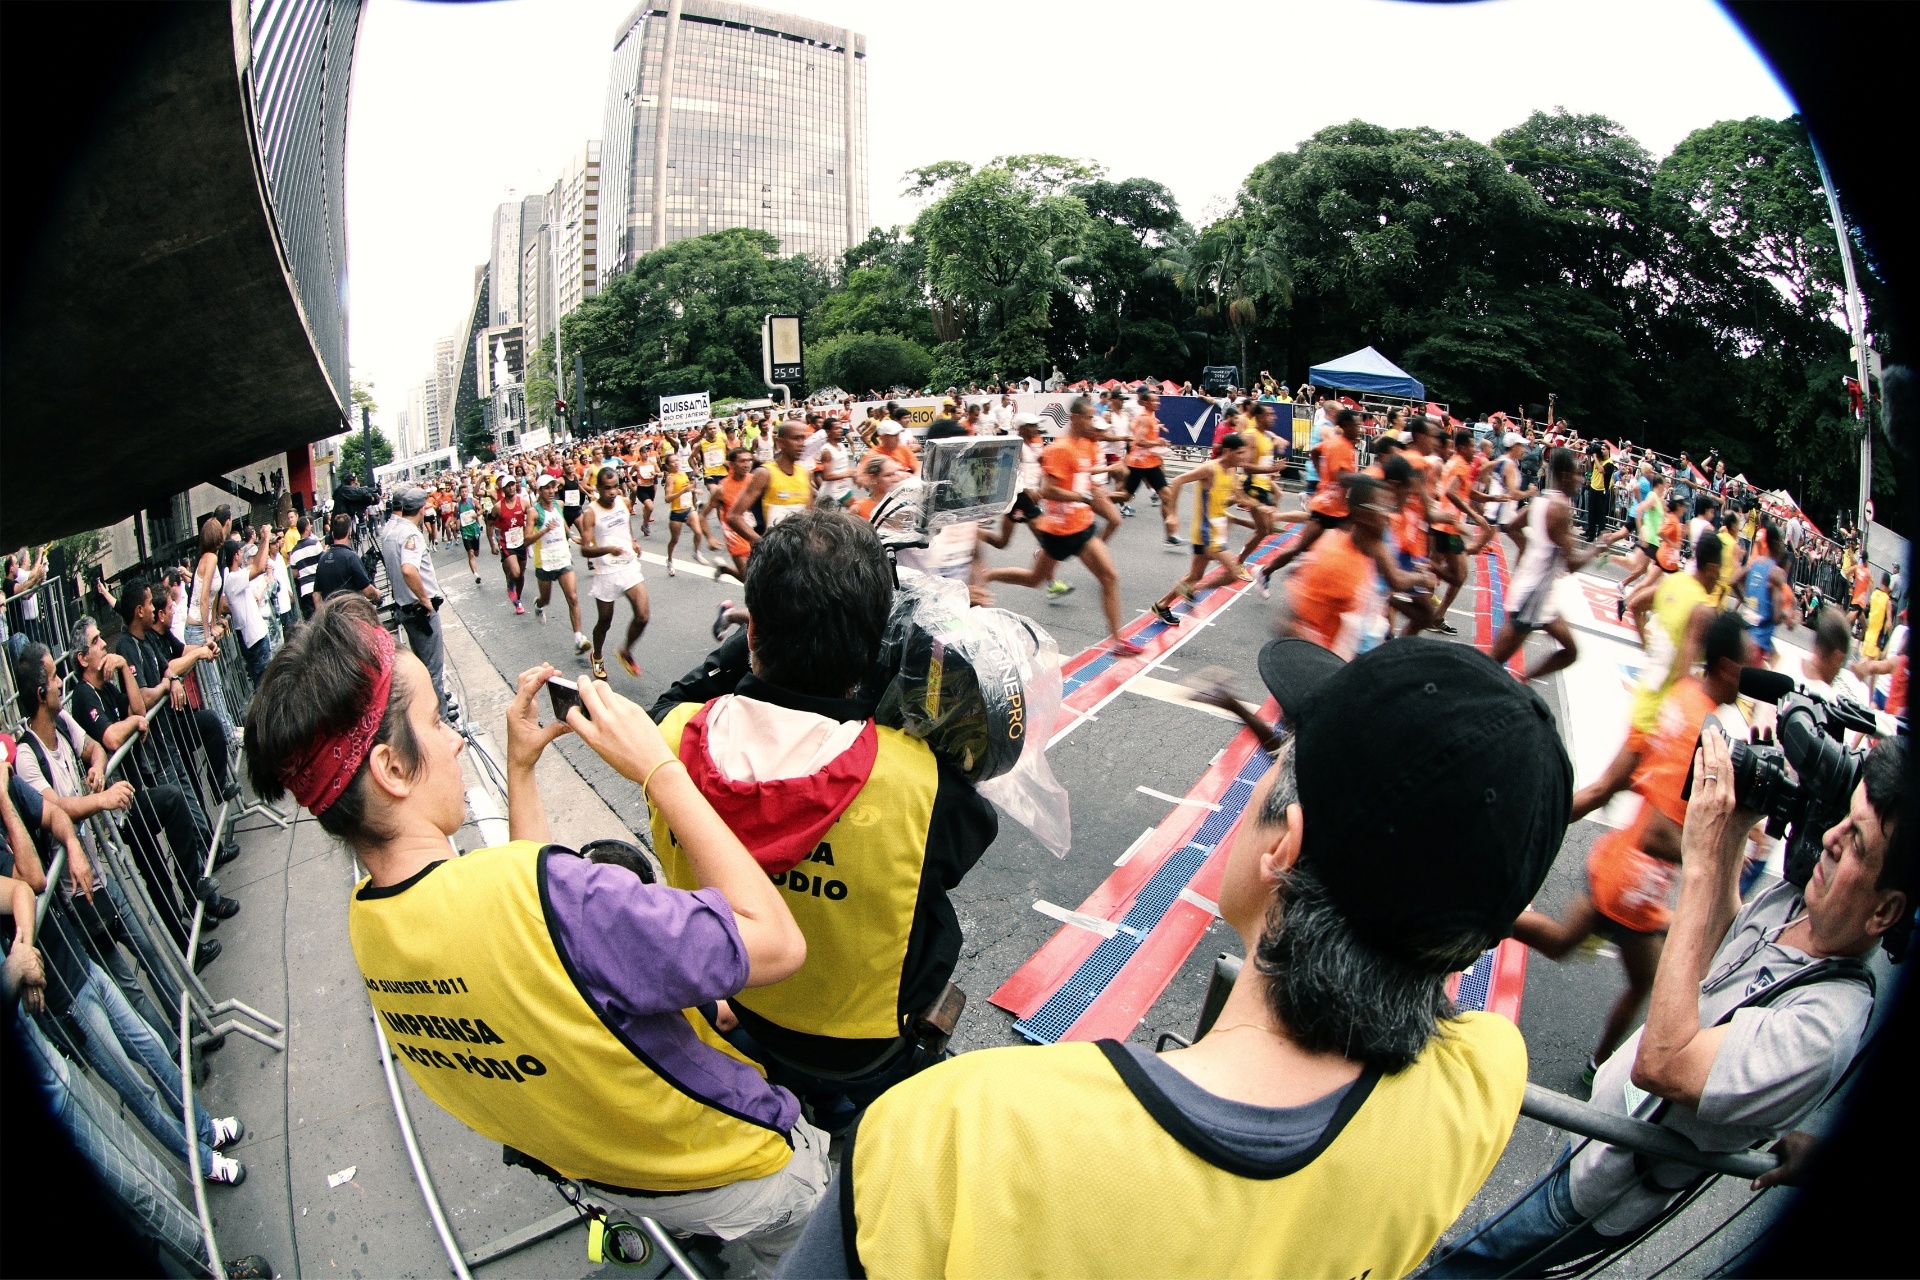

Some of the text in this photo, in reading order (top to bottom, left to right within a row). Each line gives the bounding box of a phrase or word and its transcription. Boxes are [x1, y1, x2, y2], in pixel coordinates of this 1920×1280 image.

[662, 395, 708, 413] QUISSAMÃ
[685, 411, 708, 420] JANEIRO
[378, 979, 435, 994] SILVESTRE
[432, 976, 469, 995] 2011
[380, 1009, 505, 1045] IMPRENSA
[396, 1042, 548, 1083] FOTO PÓDIO
